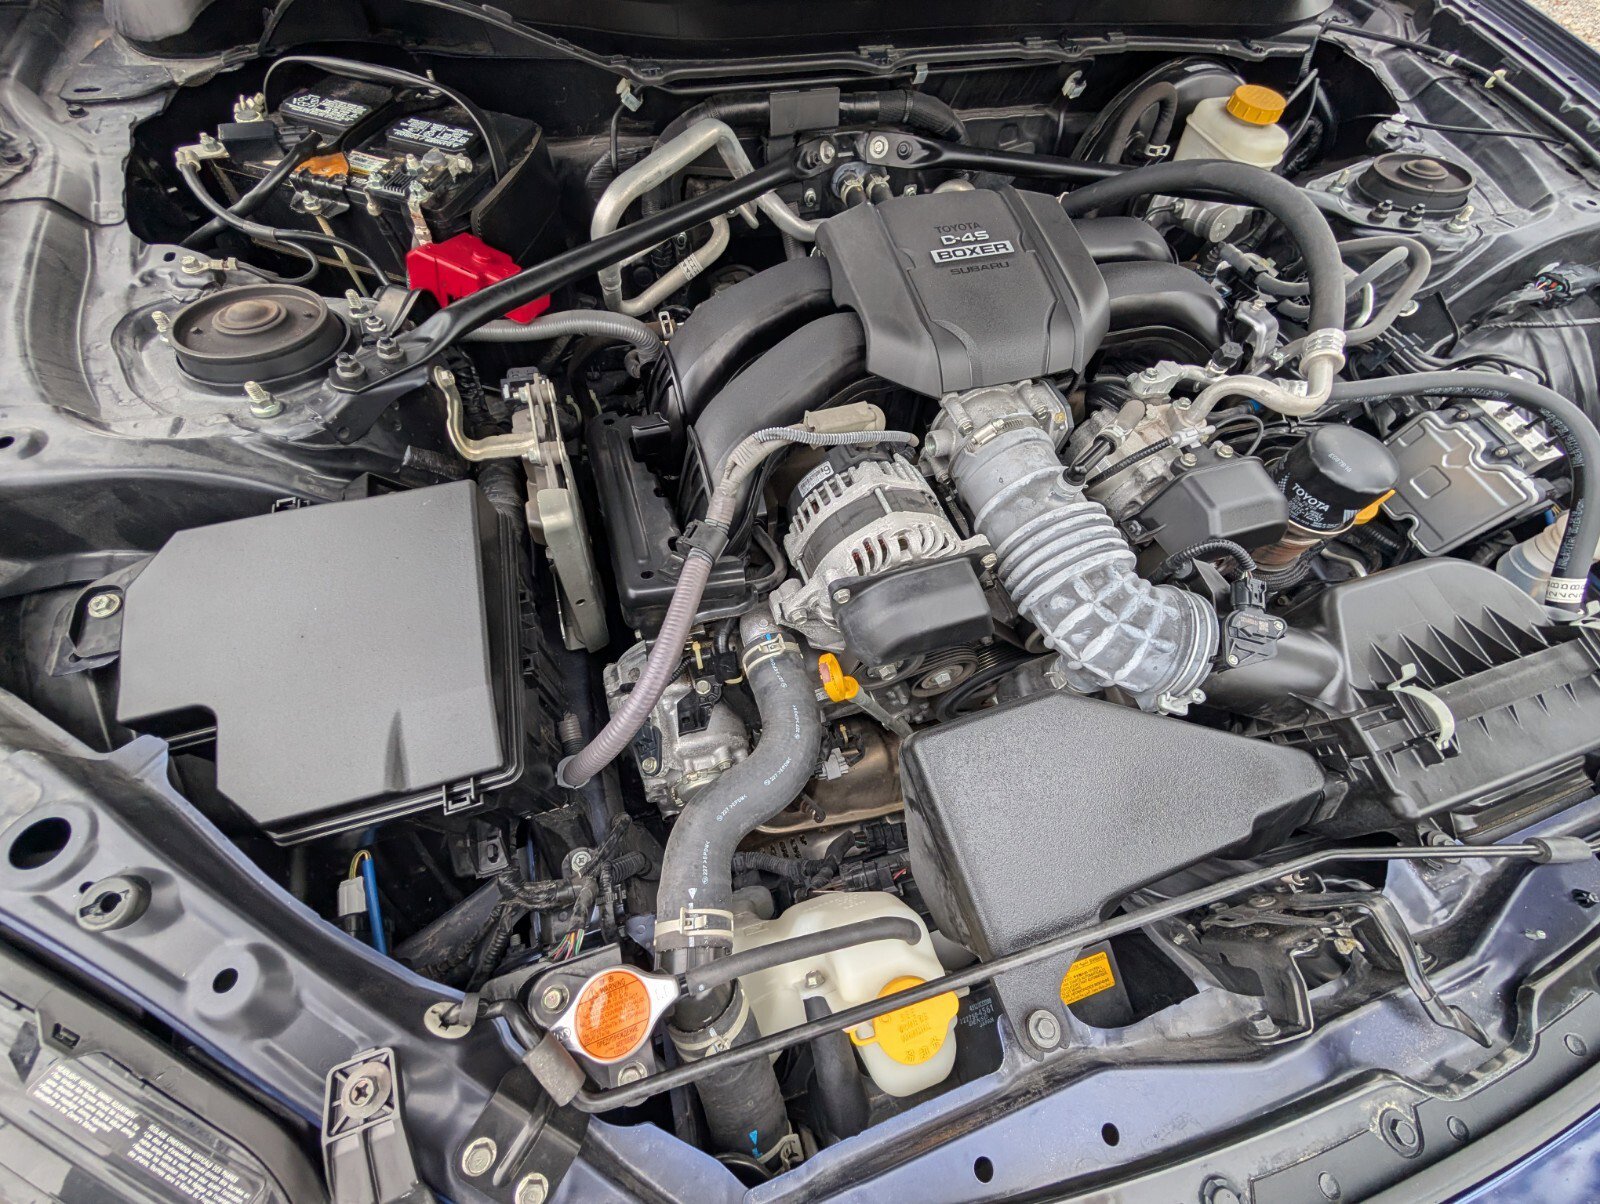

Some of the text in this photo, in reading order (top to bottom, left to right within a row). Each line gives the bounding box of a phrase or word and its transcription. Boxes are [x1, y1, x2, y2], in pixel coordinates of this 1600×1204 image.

[934, 222, 981, 233] TOYOTA
[941, 231, 989, 245] D-4S
[937, 243, 1009, 260] BOXER
[950, 261, 1009, 275] SUBARU
[1292, 483, 1330, 512] TOYOTA
[600, 978, 626, 993] WARNING
